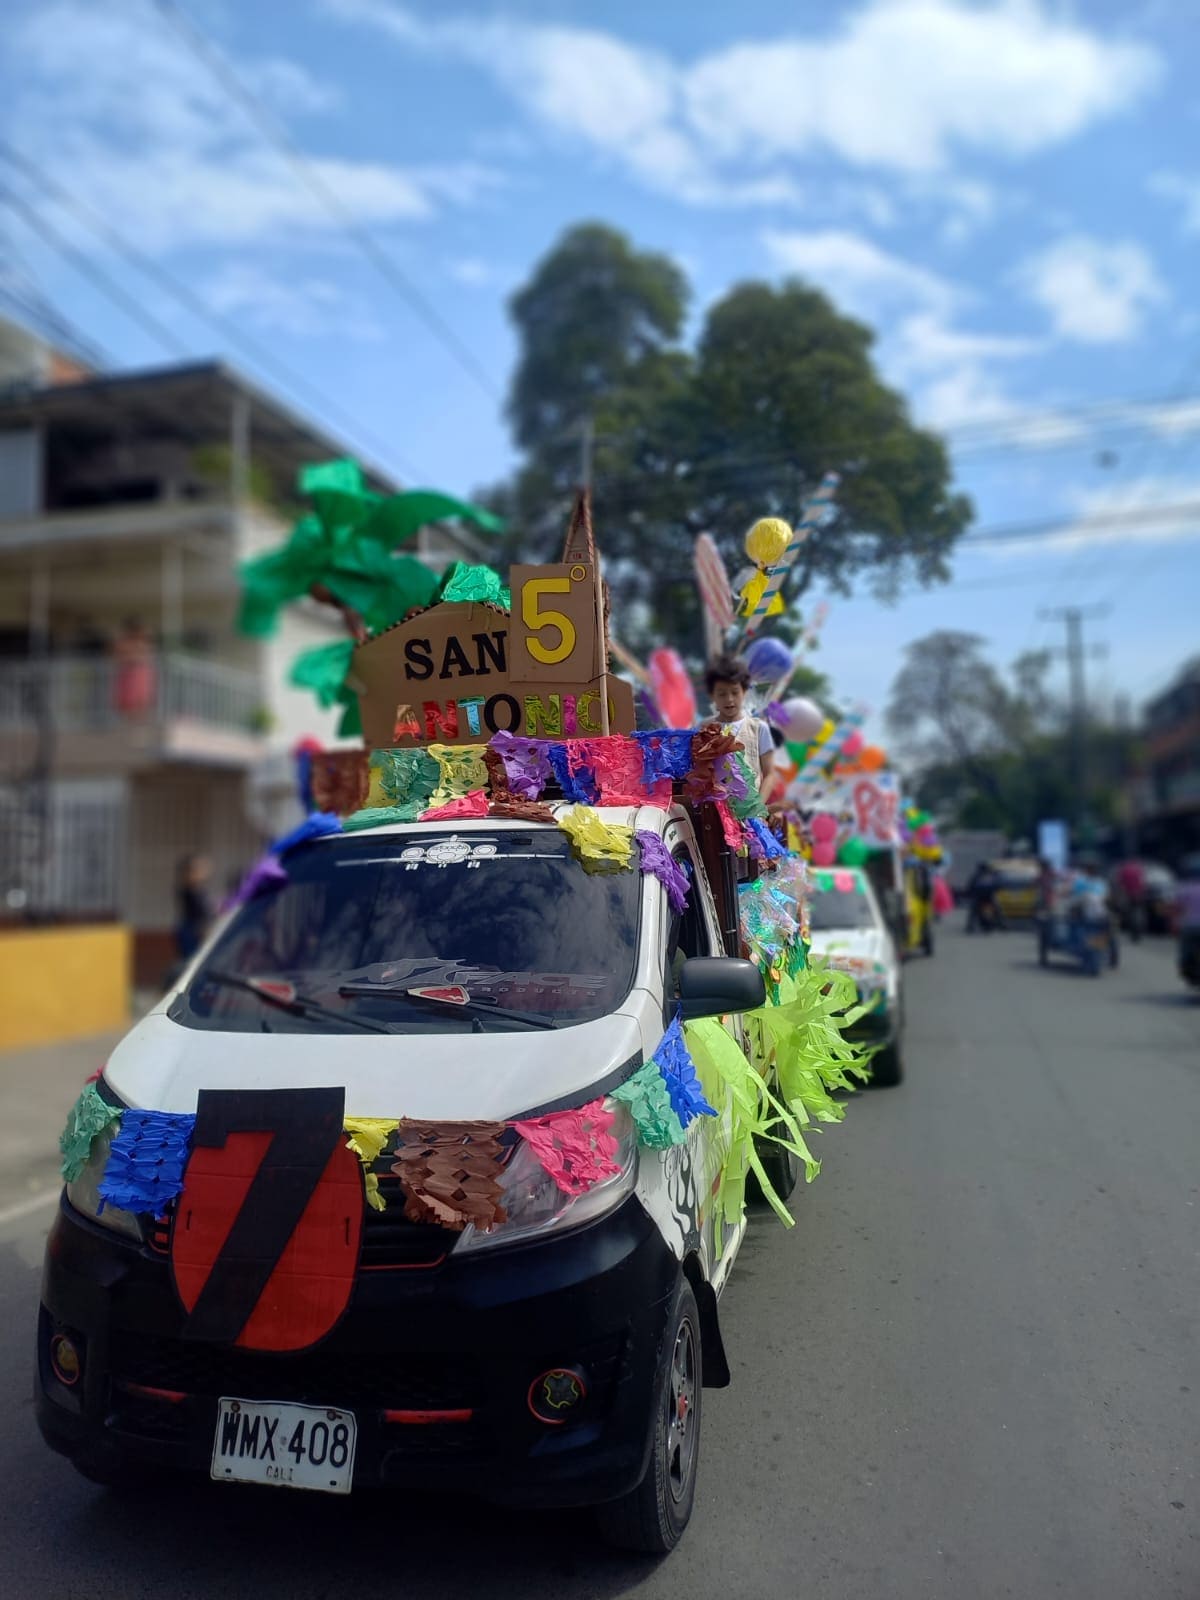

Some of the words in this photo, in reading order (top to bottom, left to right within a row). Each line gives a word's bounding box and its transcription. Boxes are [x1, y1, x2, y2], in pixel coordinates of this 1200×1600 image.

[403, 630, 508, 681] SAN
[393, 689, 615, 743] ANTONIO
[181, 1086, 346, 1343] 7
[221, 1411, 280, 1462] WMX
[287, 1419, 350, 1469] 408
[265, 1465, 294, 1482] CALI
